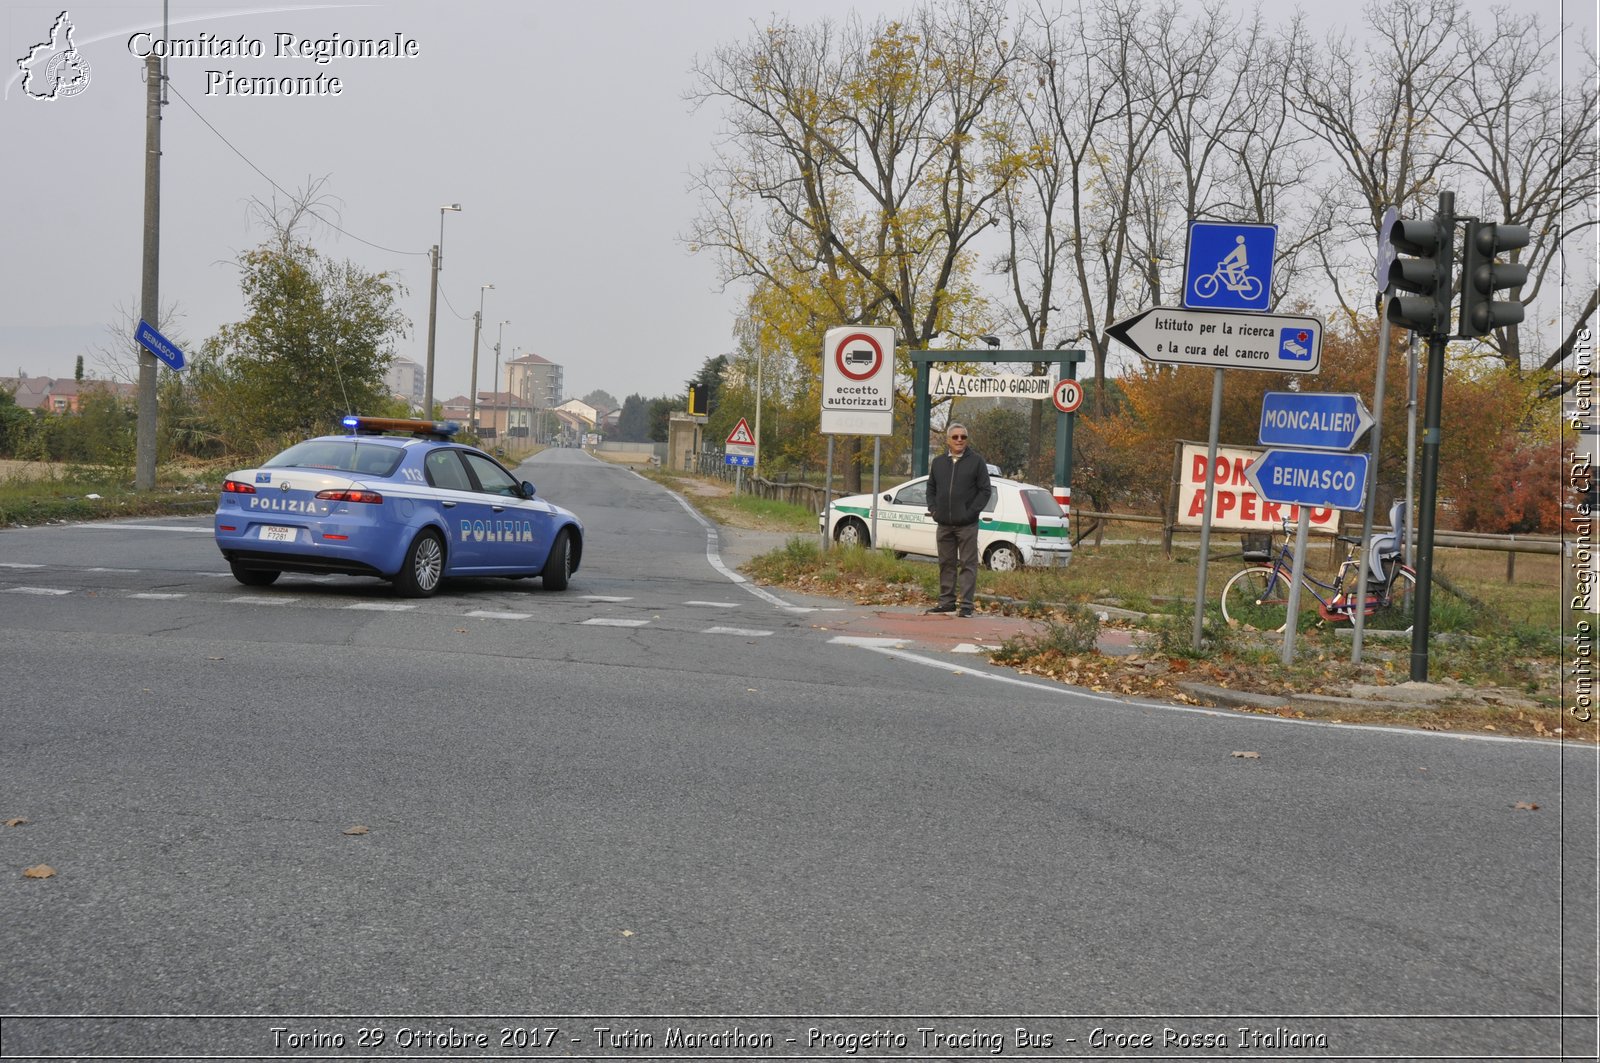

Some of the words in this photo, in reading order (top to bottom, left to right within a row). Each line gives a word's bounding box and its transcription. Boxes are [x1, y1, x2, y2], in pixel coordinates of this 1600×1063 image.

[1155, 317, 1194, 332] Istituto
[1199, 321, 1217, 335] per
[1222, 322, 1233, 335] la
[1239, 325, 1275, 337] ricerca
[143, 330, 175, 360] BEINASCO
[1156, 343, 1163, 353] e
[1168, 341, 1179, 354] la
[1185, 346, 1207, 357] cura
[1213, 344, 1229, 358] del
[1235, 349, 1270, 360] cancro
[836, 385, 879, 395] eccetto
[967, 377, 1007, 394] CENTRO
[1009, 378, 1050, 394] GIARDINI
[828, 396, 887, 406] autorizzati
[1061, 388, 1075, 404] 10
[1264, 409, 1356, 433] MONCALIERI
[402, 468, 424, 481] 113
[1192, 454, 1255, 487] DOM
[1273, 466, 1356, 491] BEINASCO
[250, 497, 317, 513] POLIZIA
[878, 511, 897, 519] POLIZIA
[461, 519, 534, 542] POLIZIA
